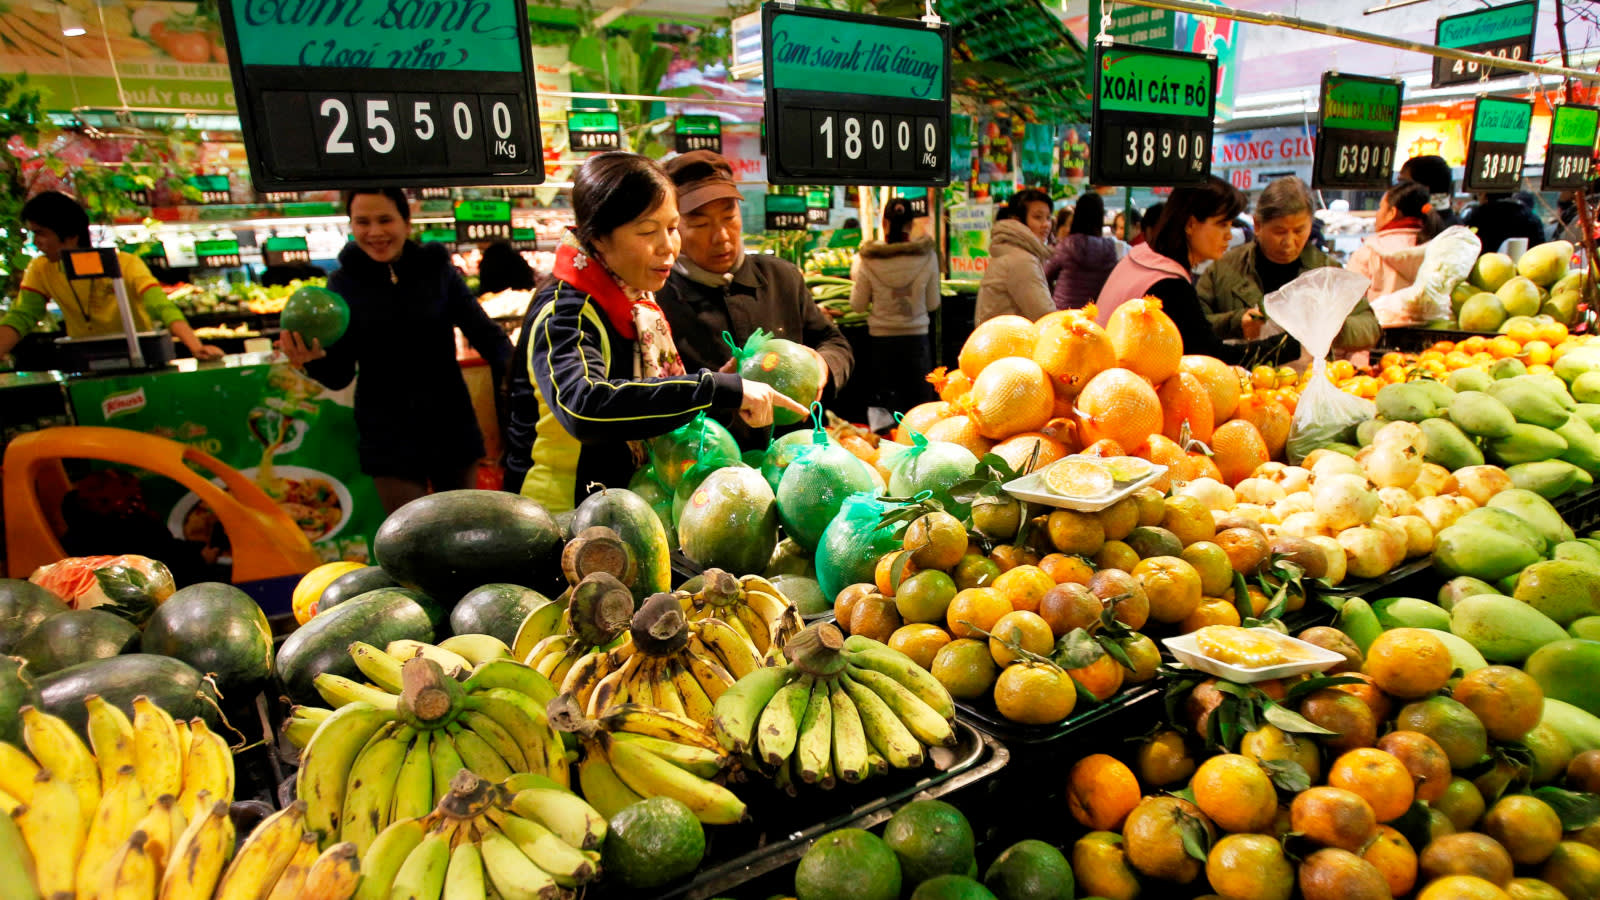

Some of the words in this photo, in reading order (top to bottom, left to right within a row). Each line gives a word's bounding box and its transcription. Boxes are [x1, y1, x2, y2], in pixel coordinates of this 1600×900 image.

[178, 90, 219, 106] RAU
[1103, 71, 1143, 102] XOÀI
[1148, 75, 1180, 105] CÁT
[1184, 75, 1206, 107] BỒ
[320, 98, 512, 154] 25500
[820, 116, 937, 160] 18000
[494, 140, 517, 159] /Kg
[922, 152, 937, 168] /Kg
[1125, 130, 1203, 166] 38900
[1339, 144, 1391, 174] 63900
[1232, 169, 1252, 190] 06
[1481, 153, 1522, 179] 38900
